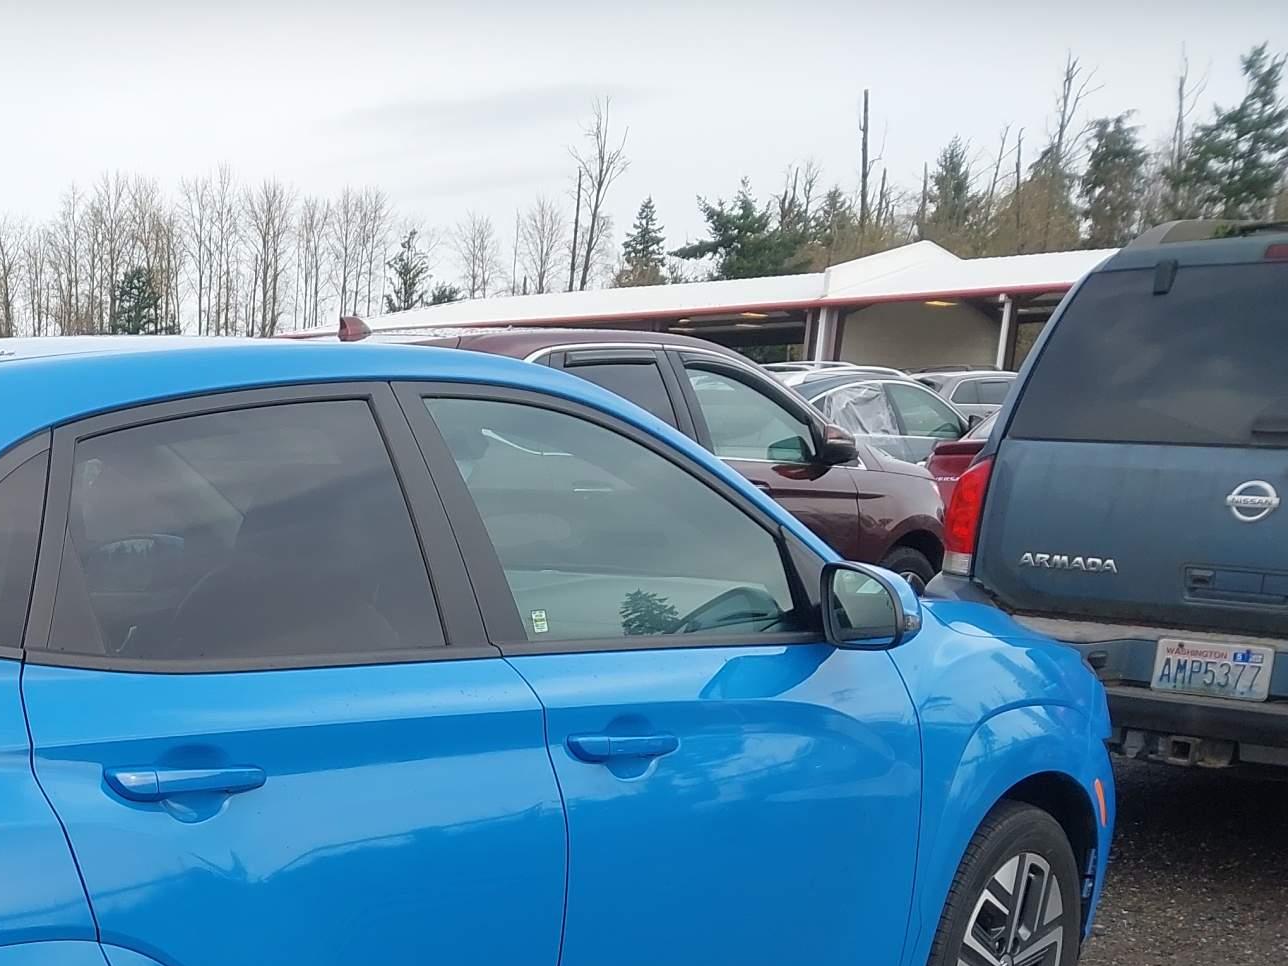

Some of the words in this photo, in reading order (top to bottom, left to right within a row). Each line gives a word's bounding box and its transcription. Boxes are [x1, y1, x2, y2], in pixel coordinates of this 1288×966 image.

[1231, 497, 1273, 506] NISSAN
[1018, 552, 1118, 574] ARMADA
[1166, 646, 1228, 660] WASHINGTON
[1159, 657, 1262, 691] AMP5377
